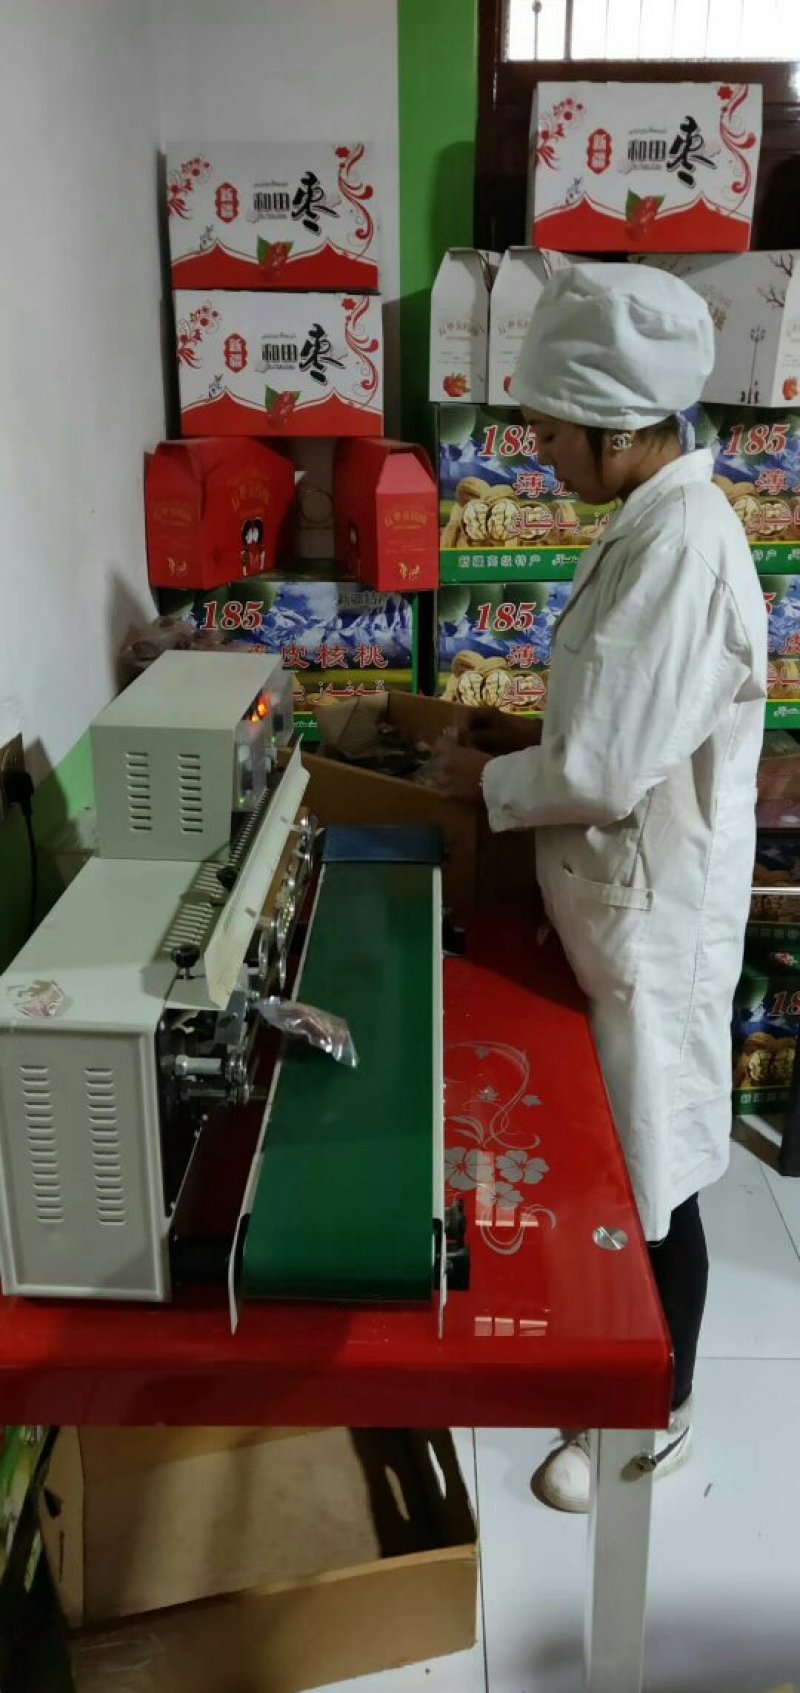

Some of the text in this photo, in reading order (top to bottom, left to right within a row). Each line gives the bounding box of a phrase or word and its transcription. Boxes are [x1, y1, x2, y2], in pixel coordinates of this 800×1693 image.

[723, 423, 790, 455] 185
[200, 600, 263, 630] 185
[473, 602, 537, 632] 185
[248, 642, 388, 670] 皮核桃
